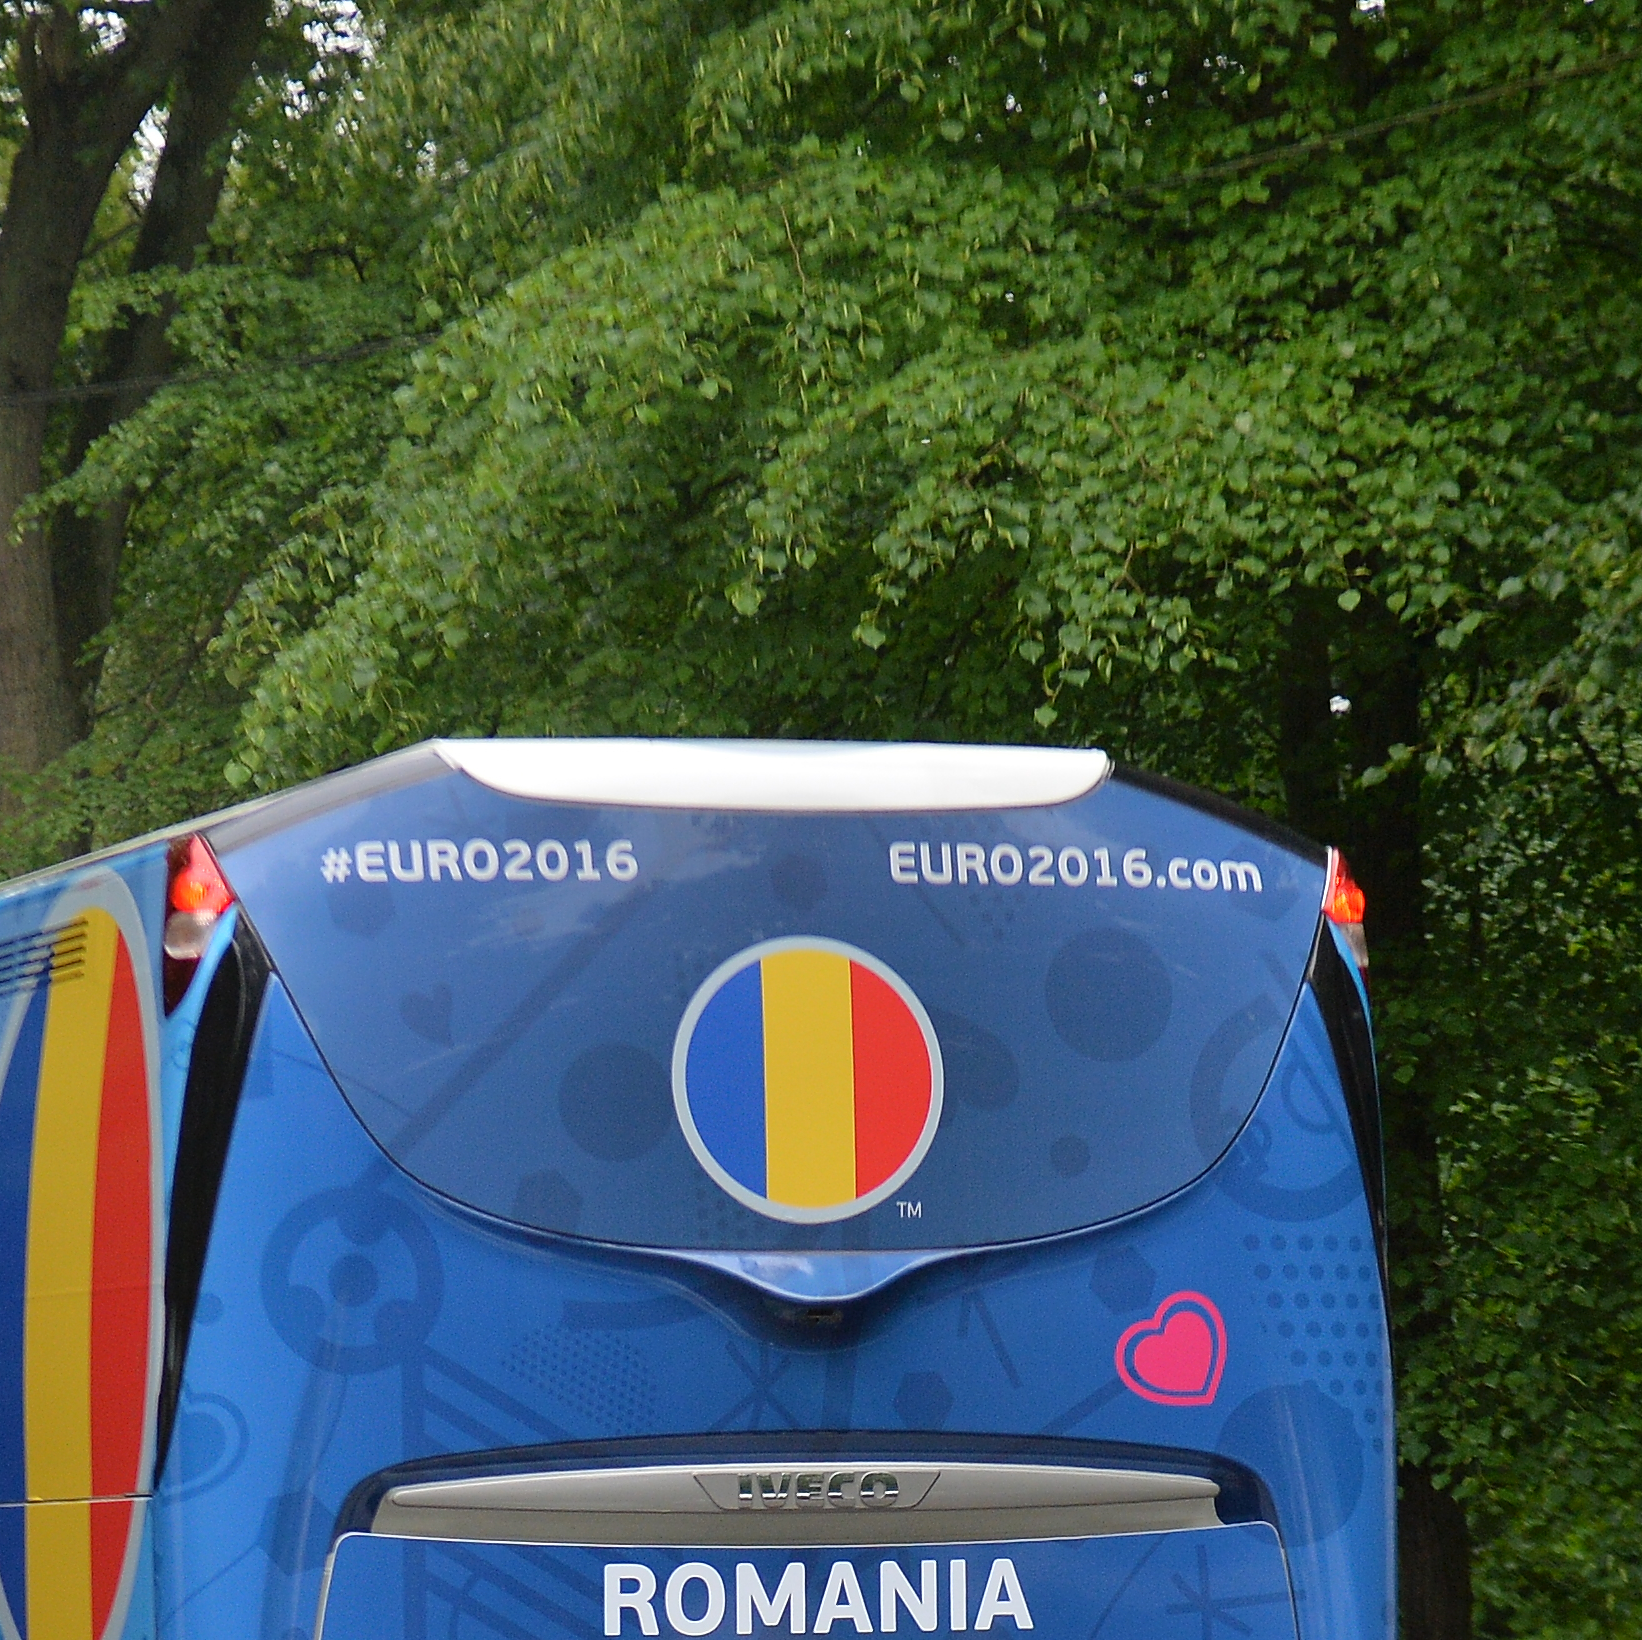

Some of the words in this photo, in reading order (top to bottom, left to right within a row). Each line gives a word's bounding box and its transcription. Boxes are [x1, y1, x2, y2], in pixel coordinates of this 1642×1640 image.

[320, 839, 638, 883] #EURO2016
[889, 841, 1263, 892] EURO2016.com
[897, 1201, 923, 1219] TM
[737, 1471, 899, 1509] IVECO
[603, 1557, 1034, 1636] ROMANIA
